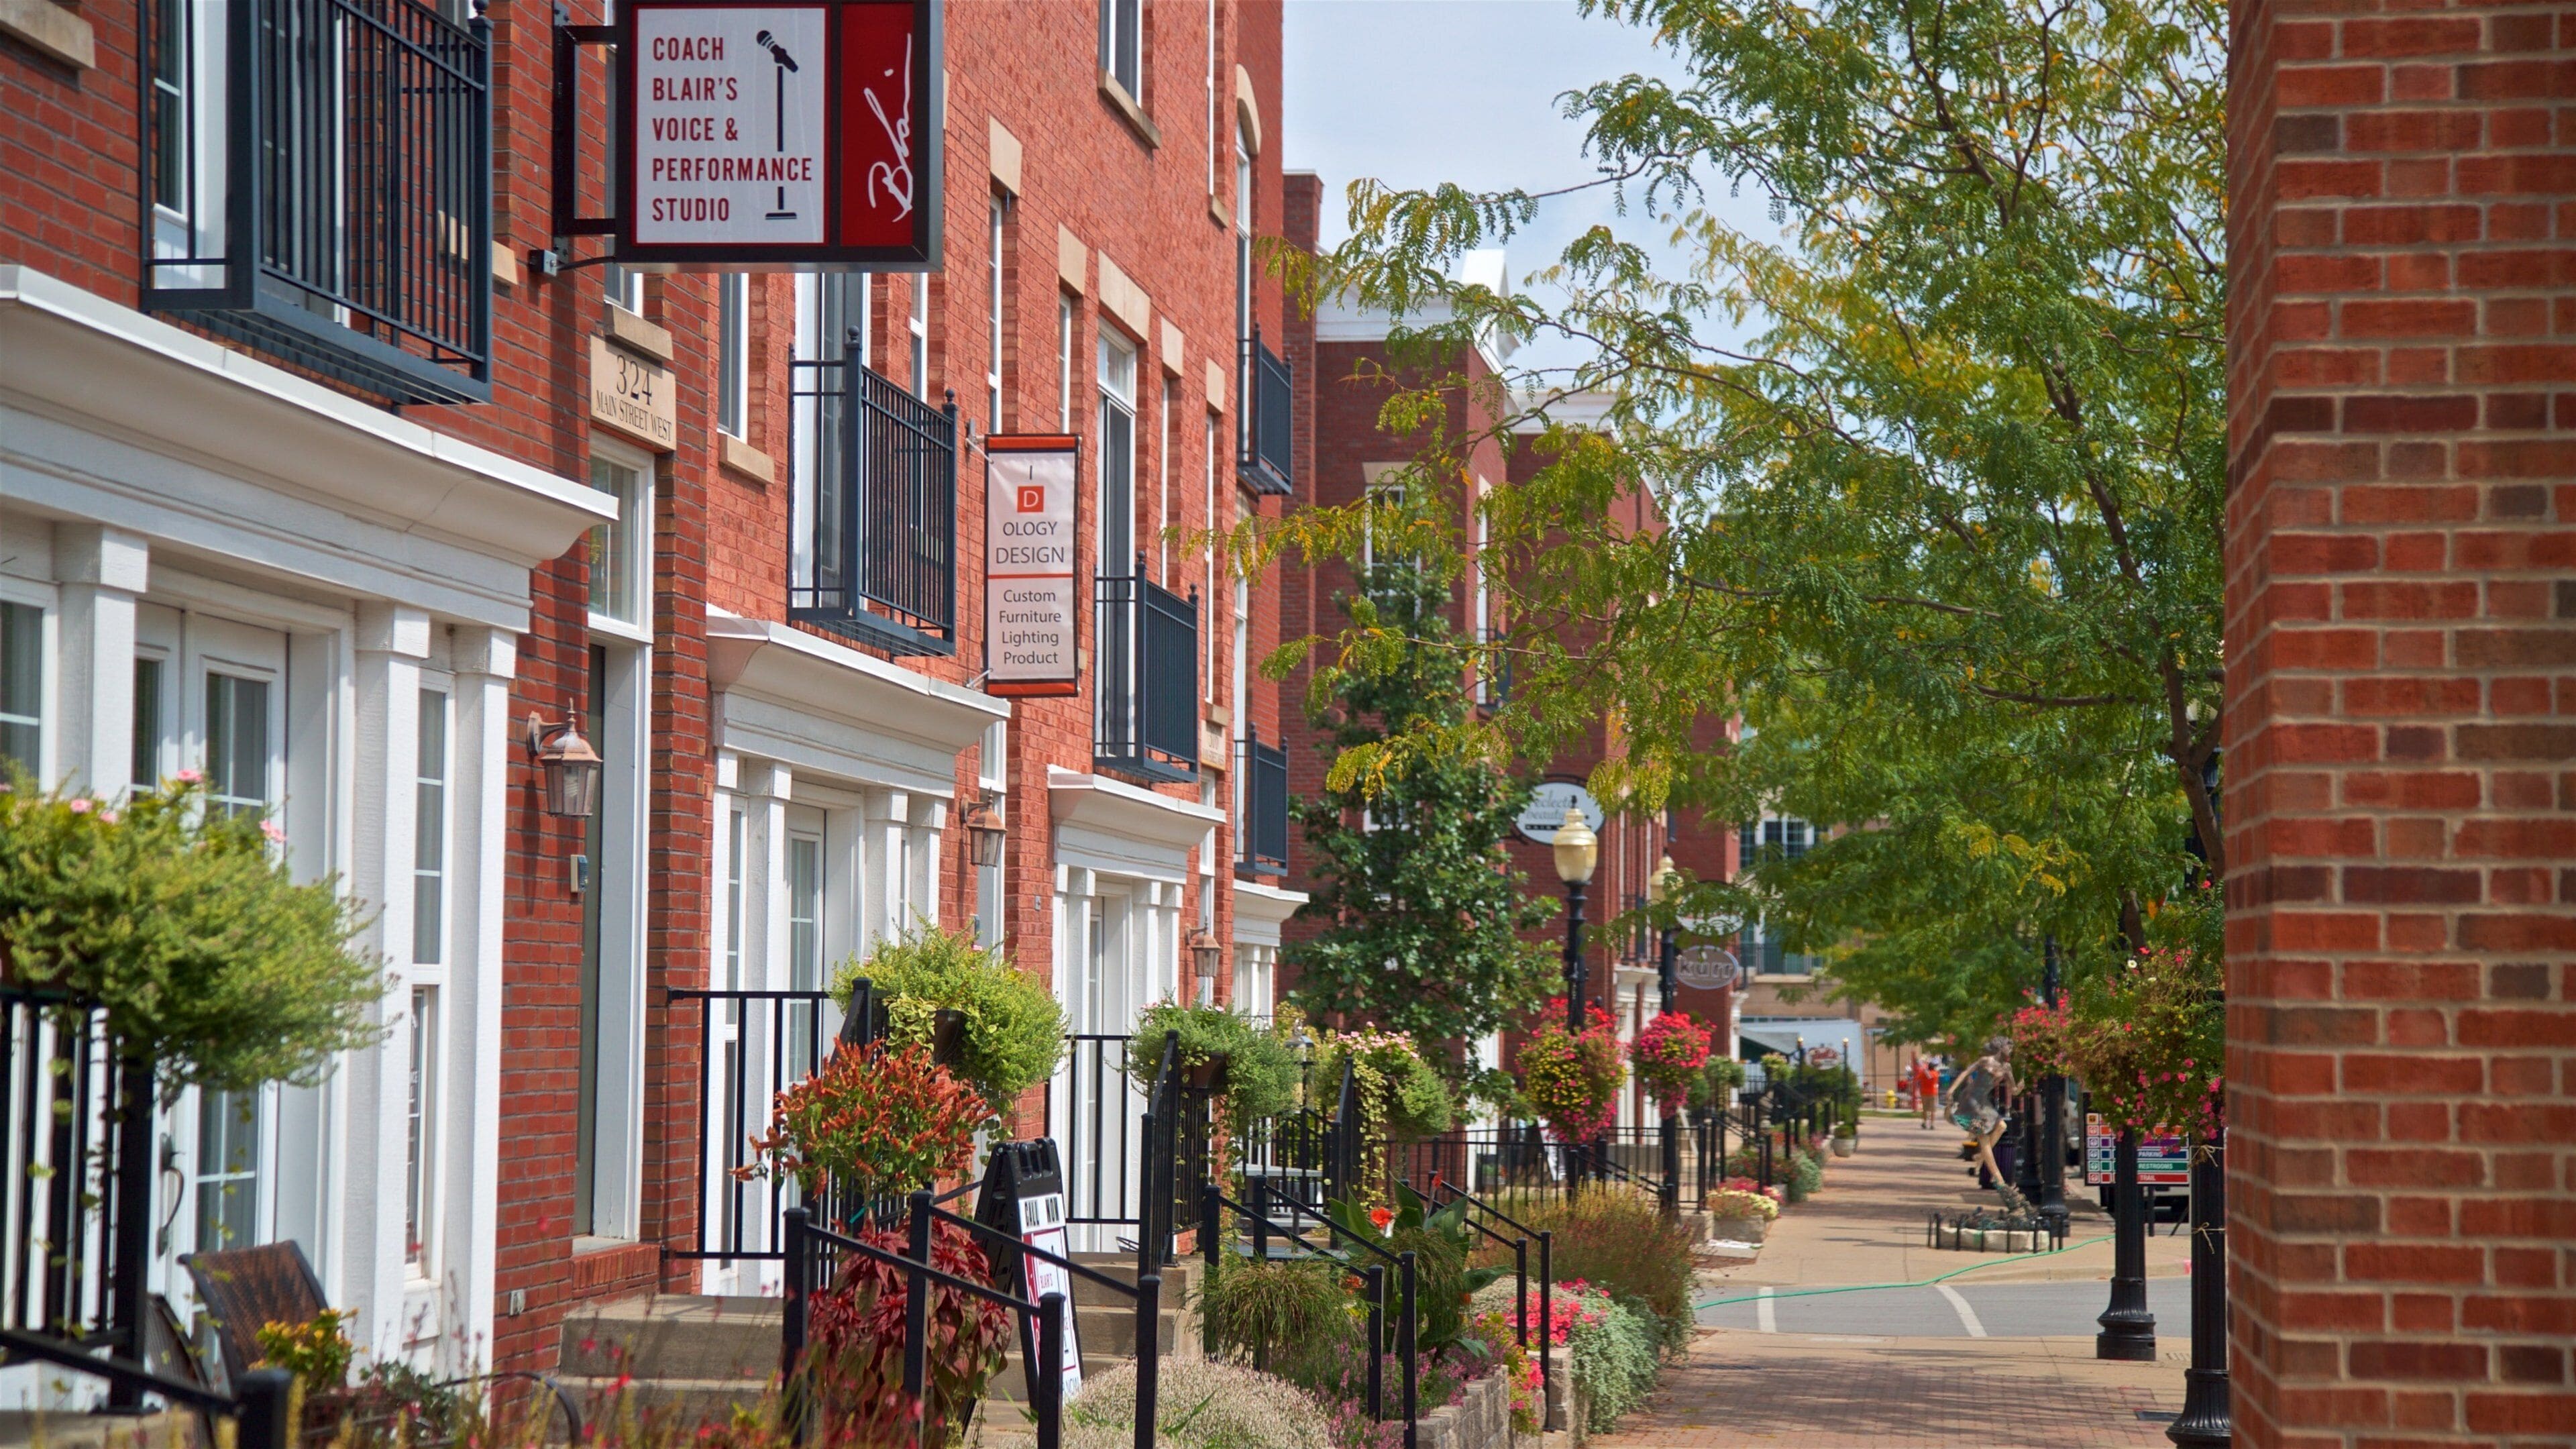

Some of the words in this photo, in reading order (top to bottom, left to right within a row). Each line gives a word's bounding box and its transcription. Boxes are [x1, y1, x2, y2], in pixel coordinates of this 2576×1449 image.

[653, 36, 724, 62] COACH
[653, 77, 738, 102] BLAIR'S
[652, 117, 715, 142] VOICE
[725, 117, 739, 142] &
[652, 157, 812, 182] PERFORMANCE
[652, 197, 730, 222] STUDIO
[616, 355, 652, 406] 324
[596, 389, 617, 419] MAIN
[619, 398, 649, 432] STREET
[651, 413, 672, 443] WEST
[1022, 490, 1039, 508] D
[1002, 521, 1059, 537] OLOGY
[996, 546, 1065, 565] DESIGN
[1003, 588, 1057, 604] Custom
[999, 609, 1062, 624] Furniture
[1002, 630, 1060, 647] Lighting
[1003, 650, 1059, 665] Product
[1024, 1199, 1040, 1228] CALL
[1044, 1195, 1061, 1223] NOW
